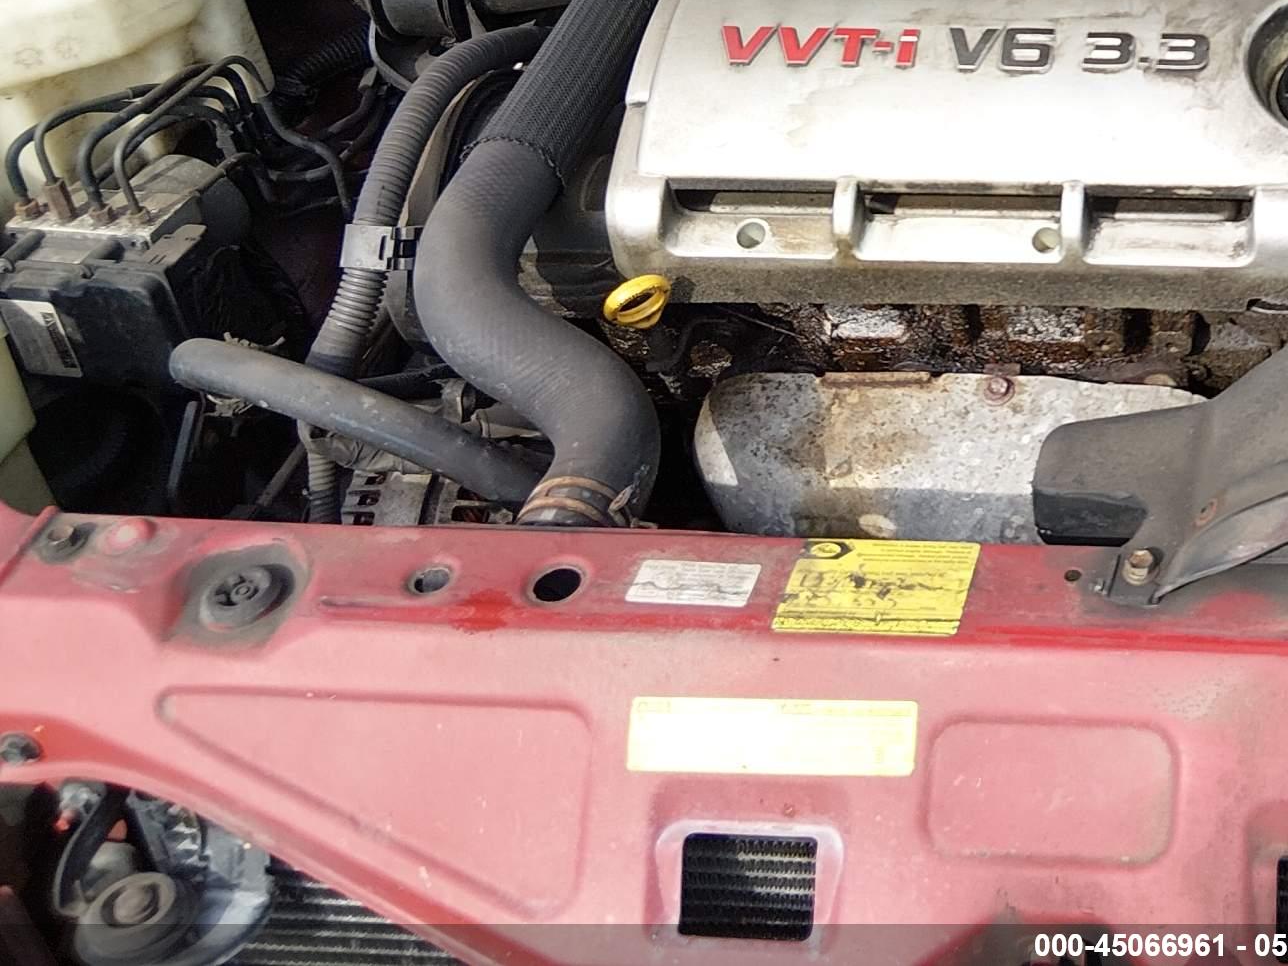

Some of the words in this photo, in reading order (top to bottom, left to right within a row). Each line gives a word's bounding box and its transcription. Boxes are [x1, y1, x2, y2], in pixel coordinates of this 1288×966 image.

[721, 24, 922, 69] VVT-i
[948, 27, 1057, 74] V6
[1081, 30, 1212, 75] 3.3
